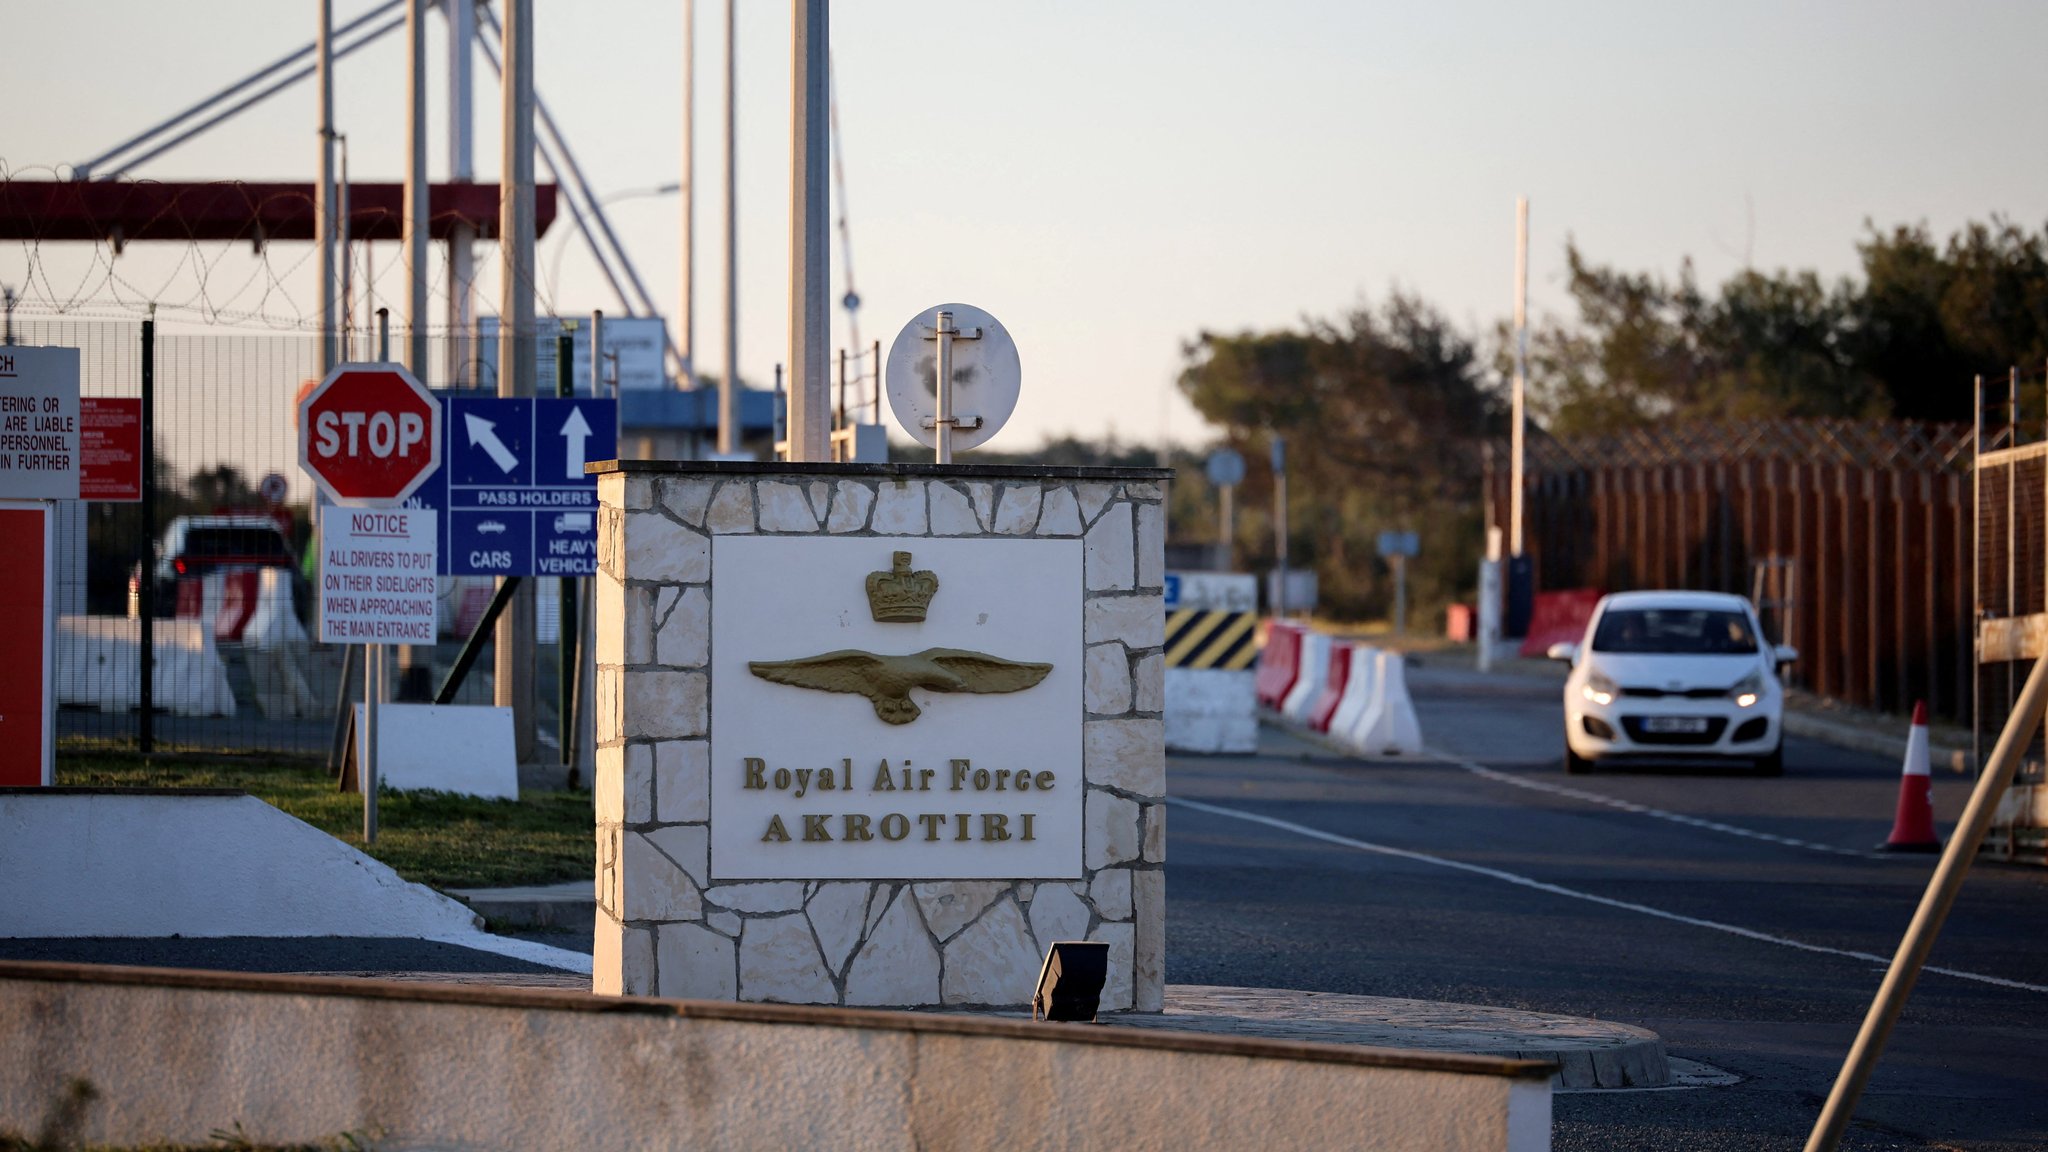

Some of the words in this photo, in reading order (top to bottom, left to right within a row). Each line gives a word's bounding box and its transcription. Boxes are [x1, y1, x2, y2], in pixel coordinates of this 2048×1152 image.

[0, 396, 36, 413] ERING
[43, 397, 59, 413] OR
[5, 415, 27, 432] ARE
[34, 416, 74, 433] LIABLE
[1, 434, 71, 451] PERSONNEL.
[315, 410, 424, 458] STOP
[18, 454, 70, 471] FURTHER
[478, 491, 517, 505] PASS
[520, 491, 592, 505] HOLDERS
[352, 513, 408, 534] NOTICE
[549, 539, 597, 555] HEAVY
[329, 550, 348, 567] ALL
[351, 551, 395, 569] DRIVERS
[397, 552, 411, 569] TO
[412, 553, 432, 570] PUT
[469, 551, 512, 569] CARS
[325, 574, 340, 591] ON
[343, 574, 372, 592] THEIR
[376, 575, 435, 594] SIDELIGHTS
[326, 597, 357, 614] WHEN
[360, 599, 433, 617] APPROACHING
[327, 620, 347, 637] THE
[350, 621, 375, 638] MAIN
[376, 622, 431, 639] ENTRANCE
[743, 757, 854, 798] Royal
[872, 758, 936, 792] Air
[950, 758, 1056, 791] Force
[760, 812, 1038, 842] AKROTIRI
